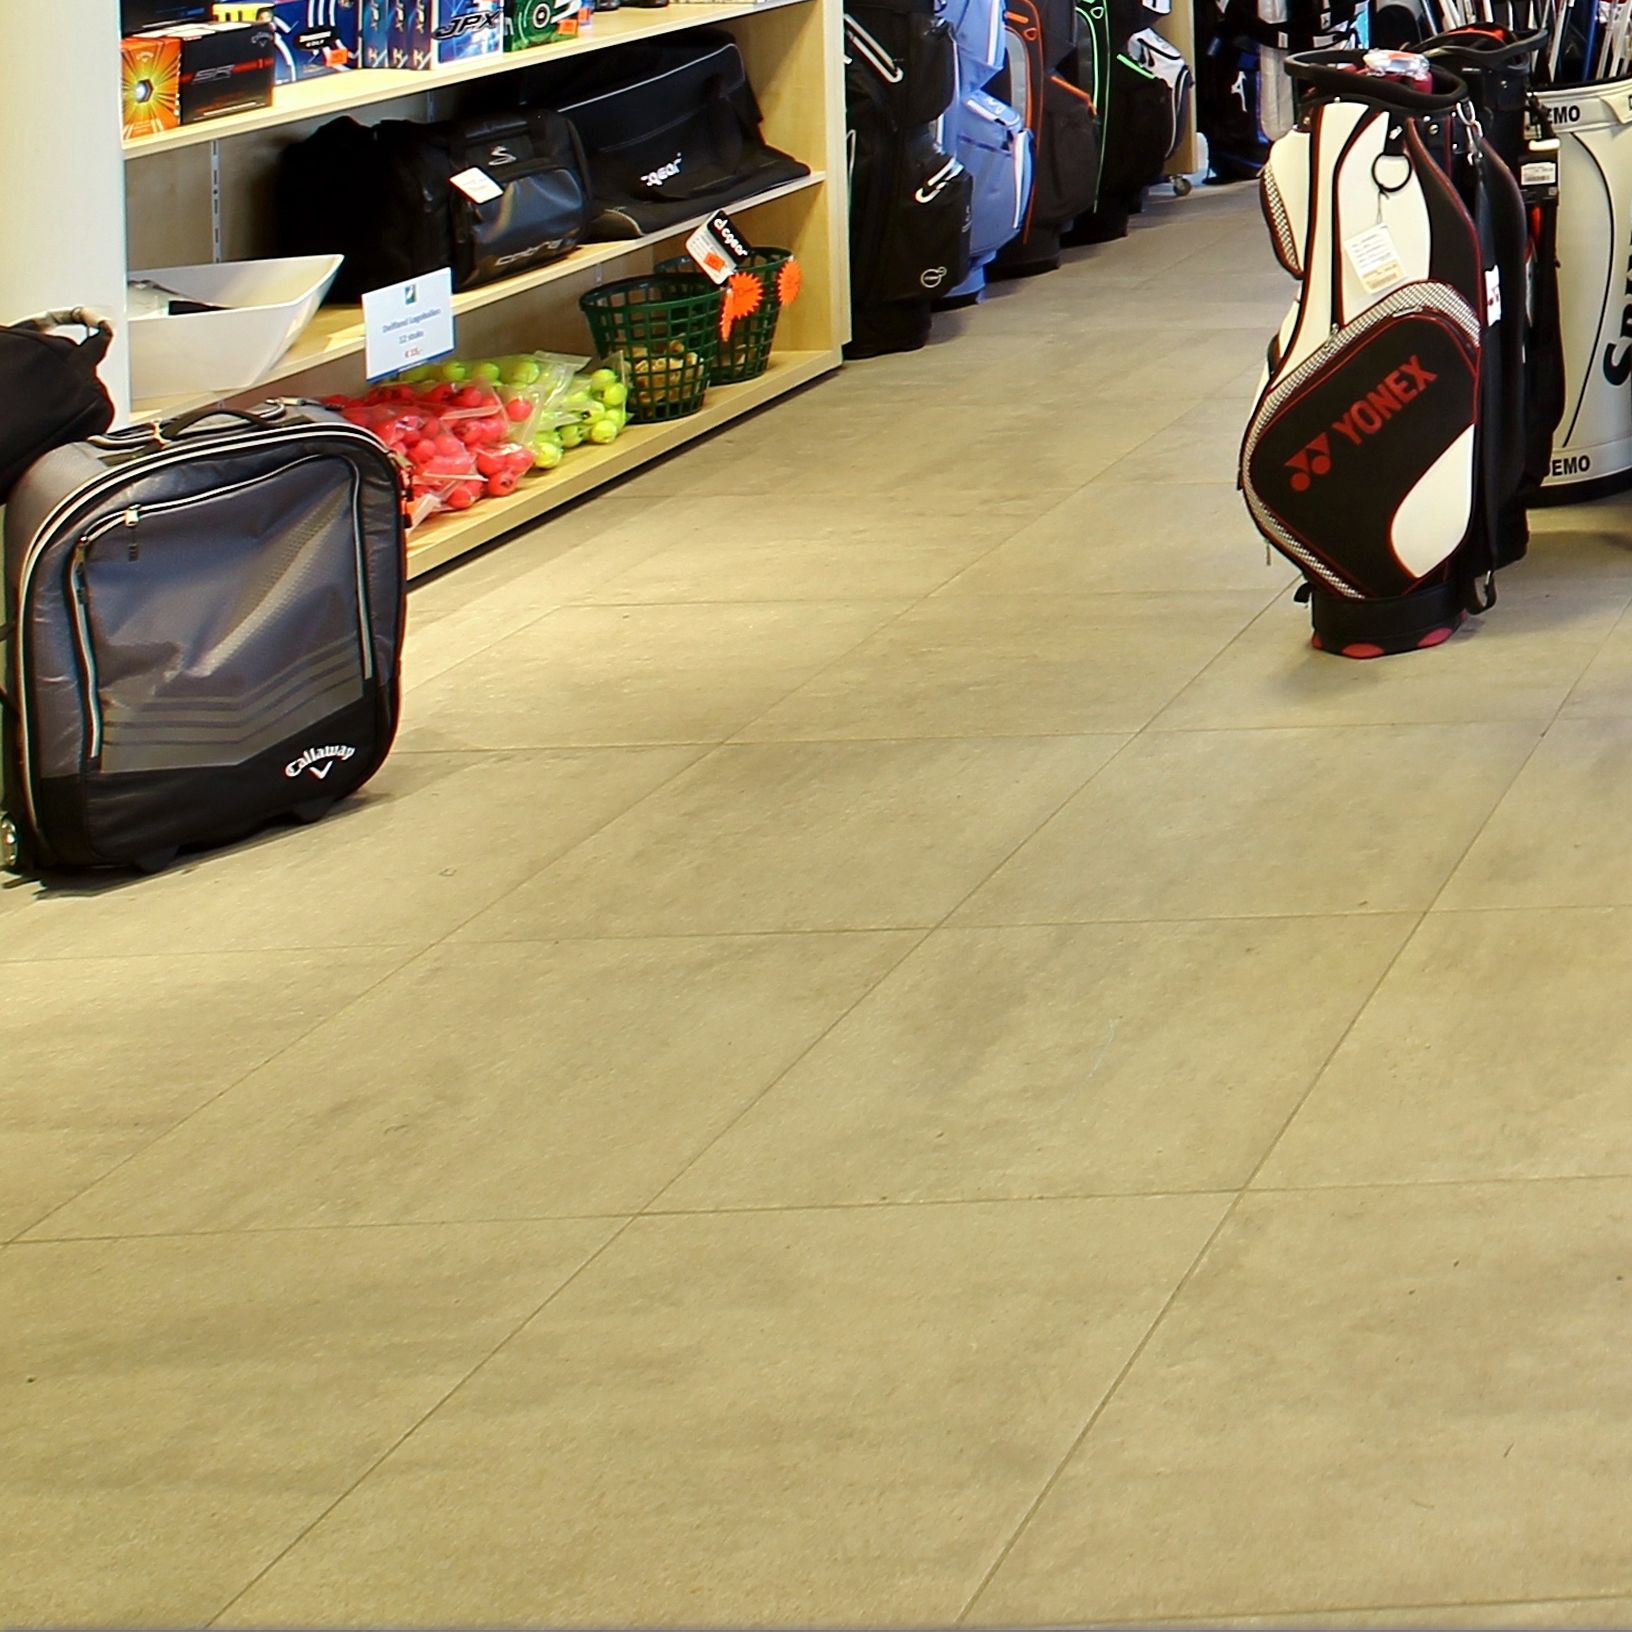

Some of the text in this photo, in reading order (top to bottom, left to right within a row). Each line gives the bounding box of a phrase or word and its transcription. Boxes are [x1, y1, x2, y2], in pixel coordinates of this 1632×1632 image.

[434, 8, 503, 41] JPX
[1547, 105, 1581, 125] EMO
[1331, 354, 1438, 447] YONEX
[1551, 454, 1591, 476] EMO
[284, 745, 356, 777] Callaway
